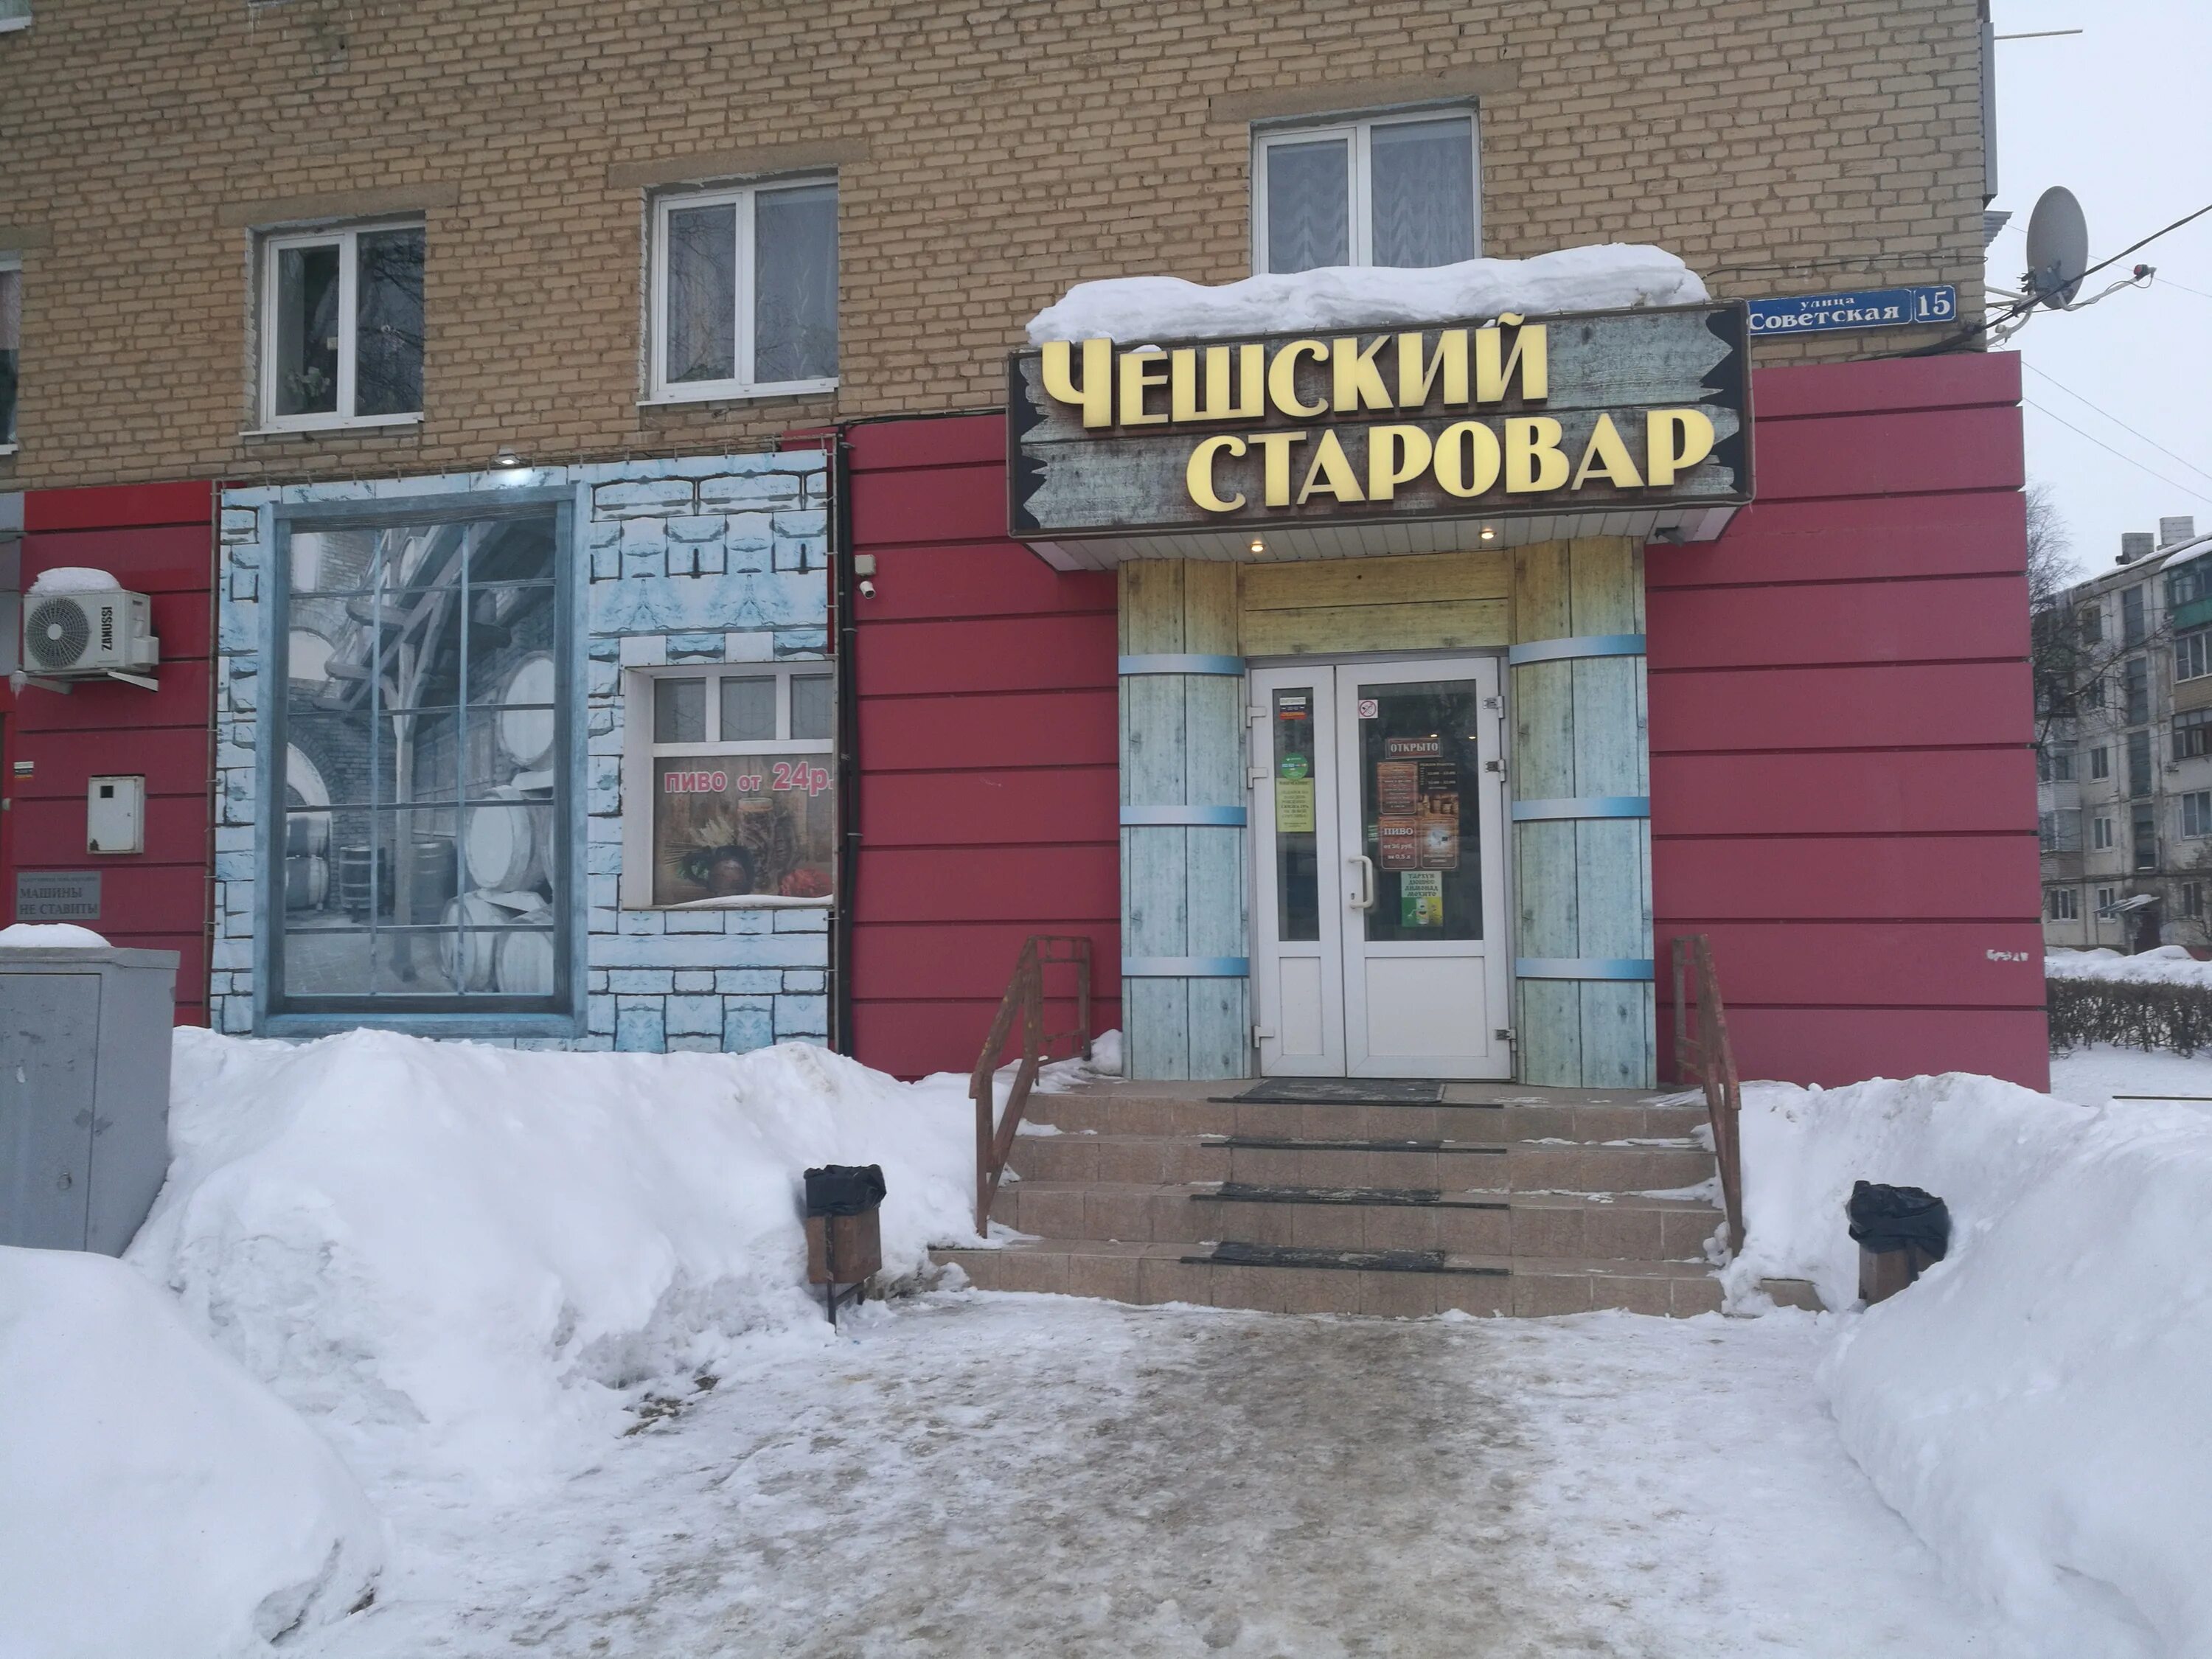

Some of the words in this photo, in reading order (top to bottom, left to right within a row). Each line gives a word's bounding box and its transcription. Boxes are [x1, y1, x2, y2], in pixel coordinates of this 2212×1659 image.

[1800, 296, 1855, 310] улица
[1918, 291, 1951, 316] 15
[1747, 305, 1900, 330] Советская
[1041, 312, 1549, 429] ЧЕШСКИЙ
[1185, 408, 1716, 513] СТАРОВАР
[101, 606, 113, 651] ZANUSSI
[1390, 742, 1439, 753] ОТКРЫТО
[737, 774, 762, 792] от
[1383, 827, 1413, 835] ПИВО
[19, 887, 83, 899] МАШИНЫ
[19, 904, 36, 915] НЕ
